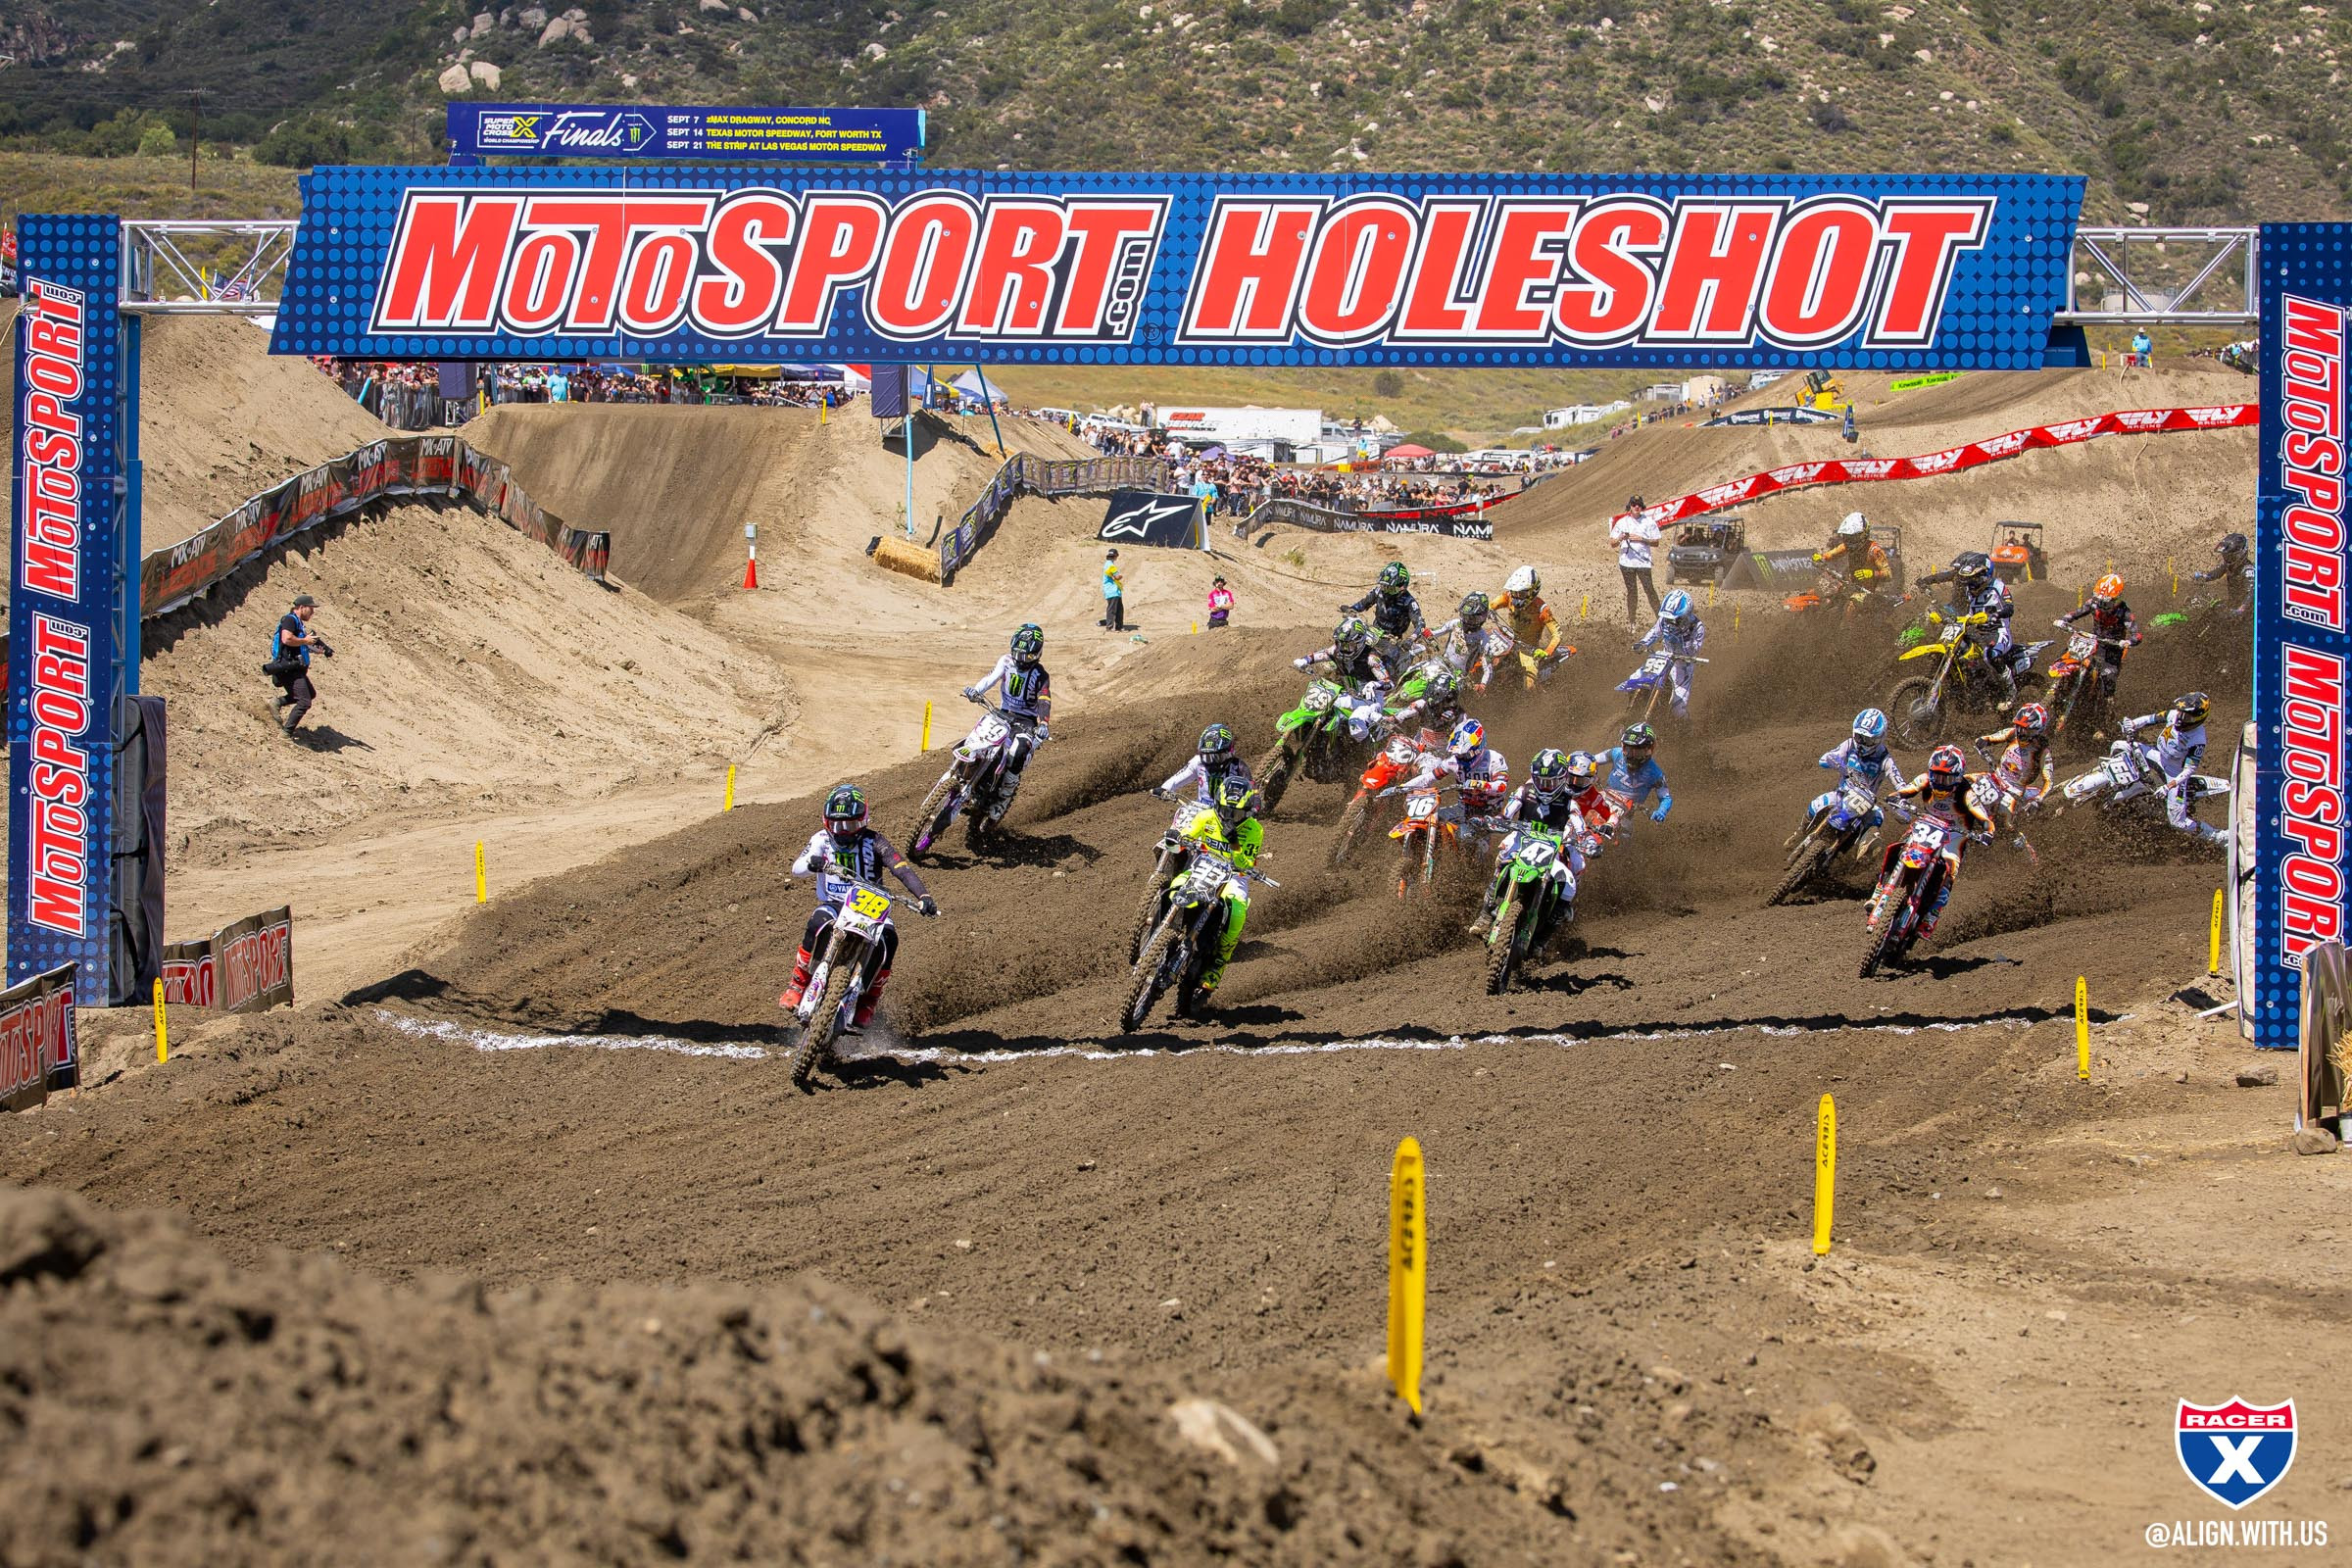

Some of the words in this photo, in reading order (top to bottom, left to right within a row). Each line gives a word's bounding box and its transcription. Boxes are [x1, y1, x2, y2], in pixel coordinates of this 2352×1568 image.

[541, 111, 624, 149] Finals
[666, 116, 691, 124] SEPT
[694, 116, 700, 124] 7
[730, 116, 774, 125] DRAGWAY,
[775, 116, 817, 124] CONCORD
[818, 117, 832, 125] NC
[693, 128, 704, 137] 14
[706, 128, 733, 137] TEXAS
[765, 129, 814, 139] SPEEDWAY,
[706, 141, 722, 150] THE
[779, 142, 808, 151] VEGAS
[808, 142, 838, 151] MOTOR
[840, 143, 887, 152] SPEEDWAY
[1178, 195, 1995, 346] HOLESHOT
[2122, 411, 2173, 425] FLY
[2189, 406, 2243, 421] FLY
[2050, 417, 2101, 438] FLY
[420, 438, 433, 456] MX
[435, 438, 455, 457] ATV
[1982, 431, 2032, 453] FLY
[1846, 460, 1897, 475] FLY
[1916, 449, 1964, 470] FLY
[1775, 463, 1827, 482] FLY
[1702, 477, 1756, 505] FLY
[1334, 517, 1374, 532] NAMURA
[1386, 521, 1439, 534] NAMURA
[1453, 523, 1493, 535] NAM
[171, 546, 187, 569] MX
[189, 534, 208, 561] ATV
[1972, 777, 2000, 805] 39
[1406, 797, 1435, 817] 16
[1912, 821, 1945, 851] 34
[862, 837, 876, 881] THOR
[1519, 842, 1555, 863] 47
[849, 888, 891, 920] 38
[1821, 1113, 1831, 1168] ACERBIS
